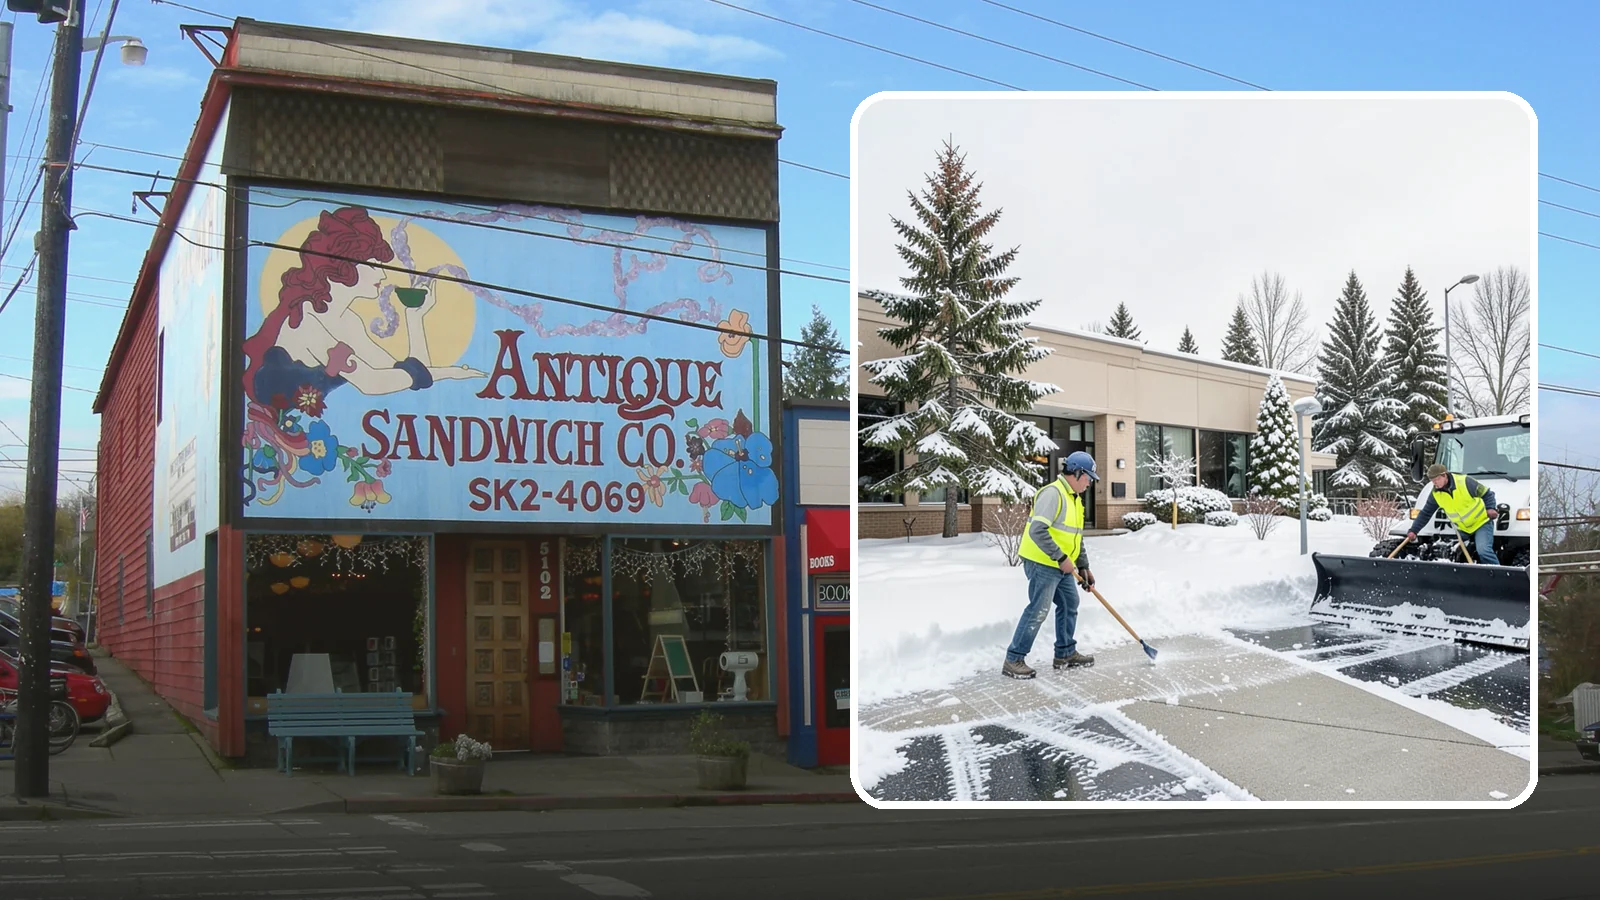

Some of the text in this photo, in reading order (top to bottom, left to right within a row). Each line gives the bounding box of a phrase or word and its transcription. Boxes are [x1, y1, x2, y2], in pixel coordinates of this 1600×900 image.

[475, 328, 724, 421] ANTIQUE
[361, 408, 685, 469] SANDWICH CO.
[468, 477, 646, 513] SK2-4069
[539, 542, 552, 600] 5102
[809, 555, 835, 569] BOOKS
